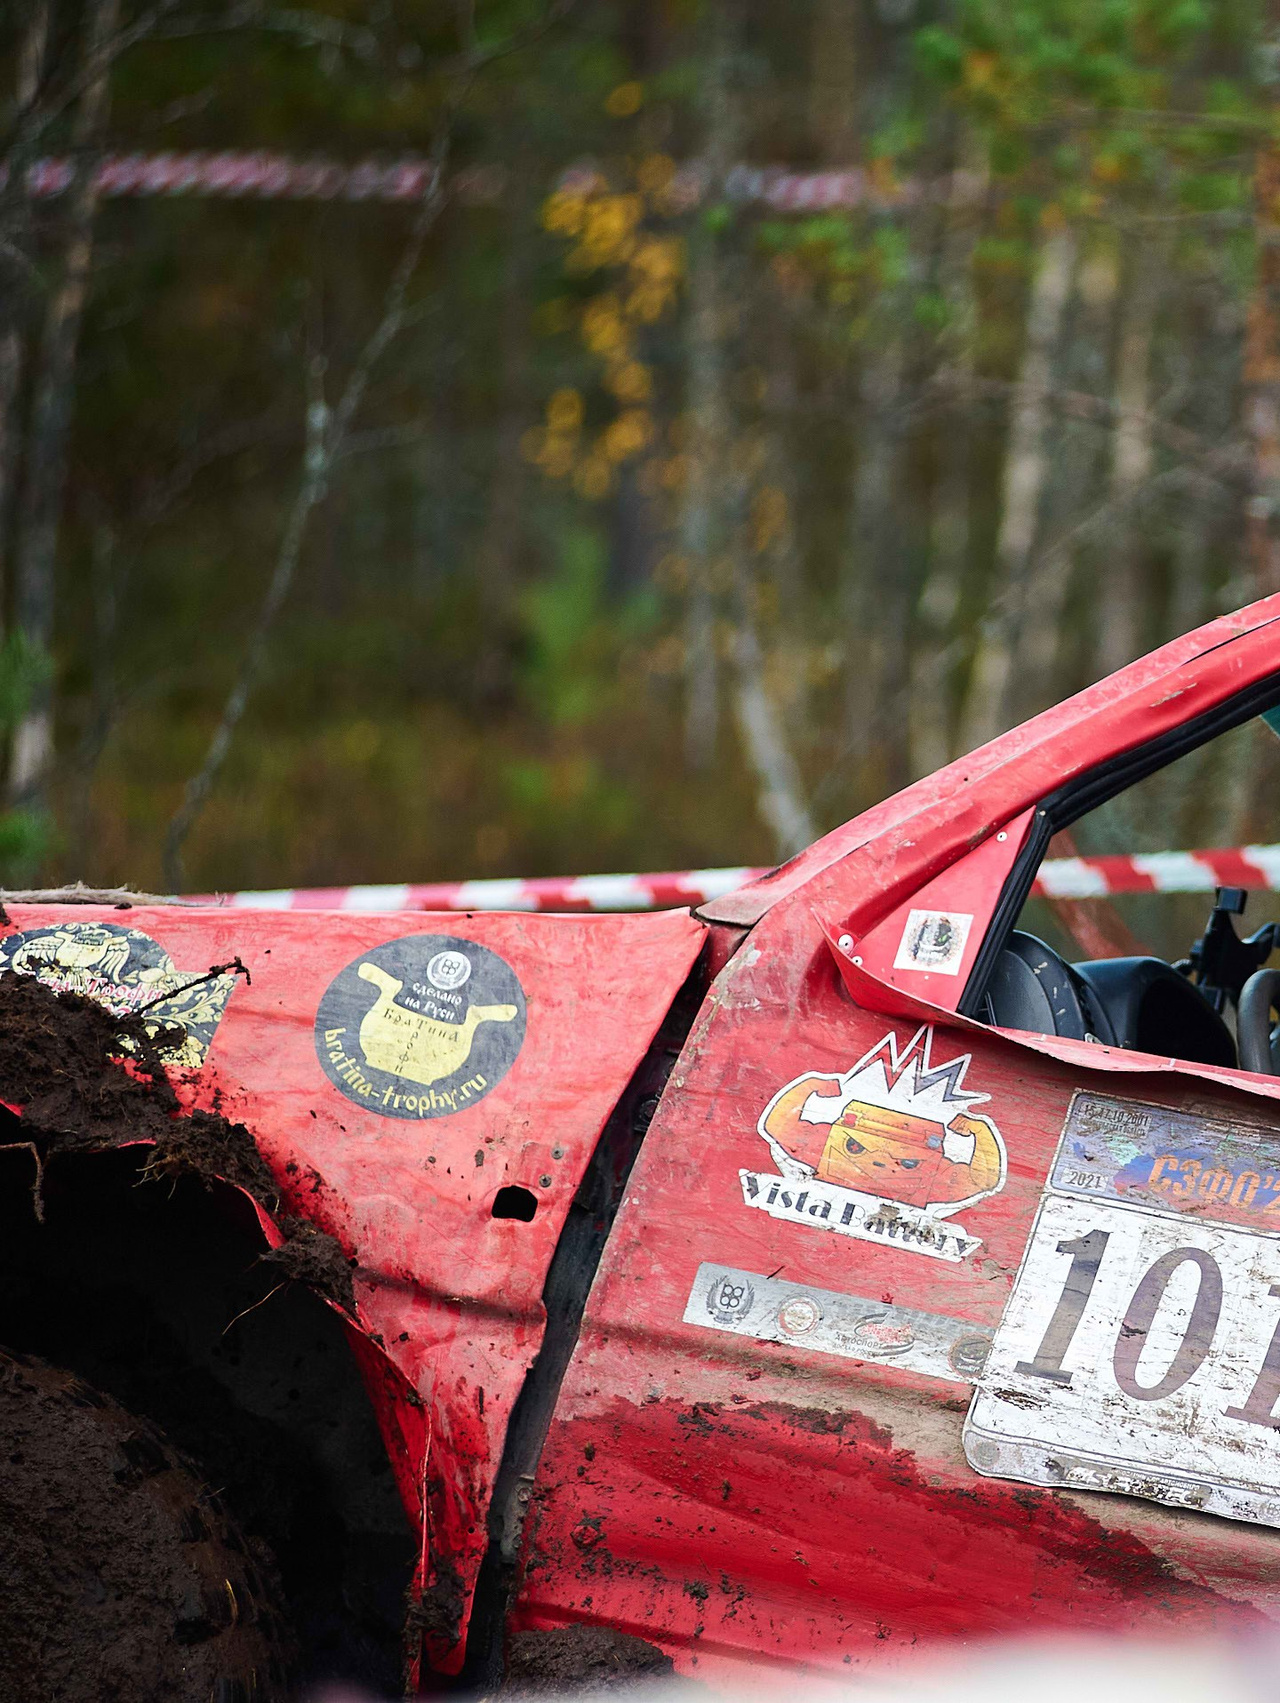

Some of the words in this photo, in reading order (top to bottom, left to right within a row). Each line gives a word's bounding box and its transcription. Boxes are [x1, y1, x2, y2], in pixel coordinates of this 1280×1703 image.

[412, 982, 463, 1006] сделано
[405, 996, 420, 1010] на
[423, 998, 455, 1021] Руси
[324, 1027, 488, 1116] bratina-trophy.ru
[1066, 1171, 1102, 1189] 2021
[746, 1176, 832, 1220] Vista
